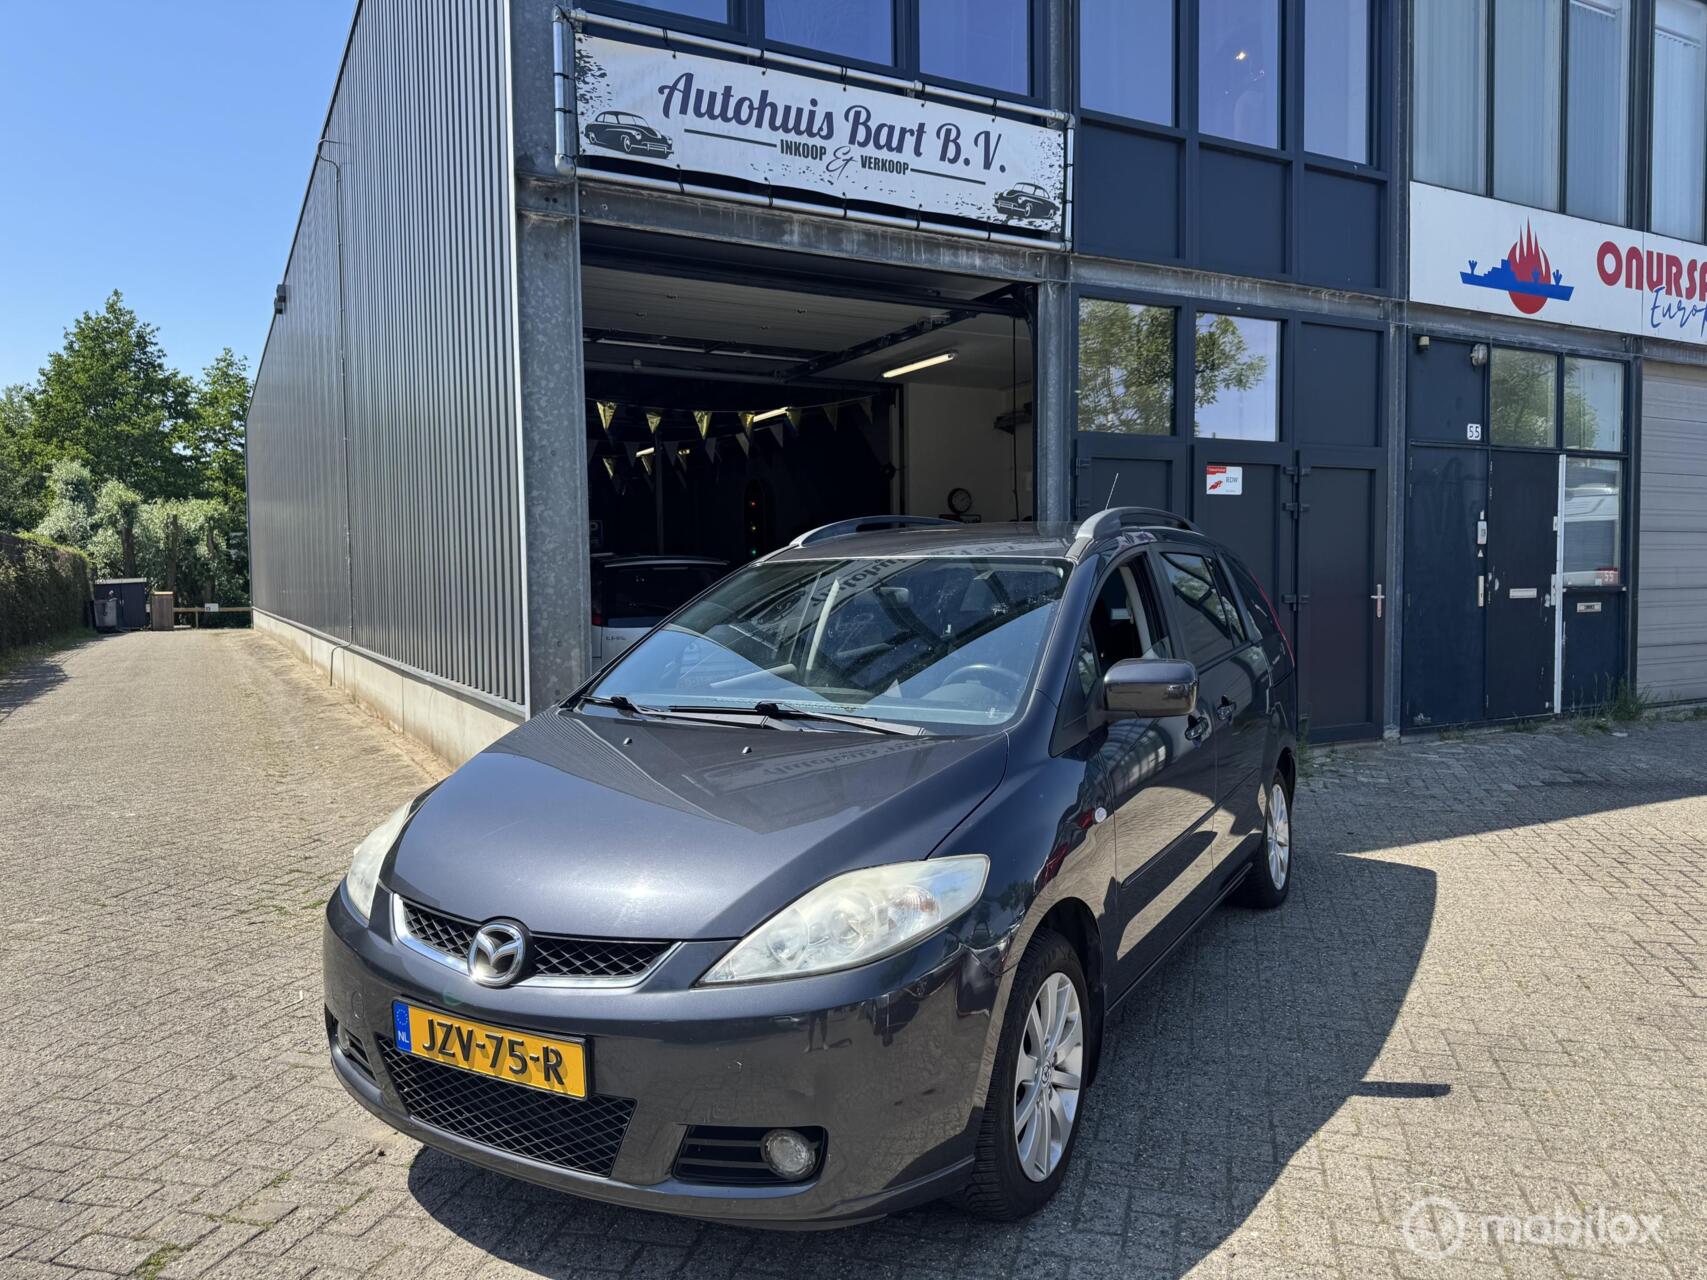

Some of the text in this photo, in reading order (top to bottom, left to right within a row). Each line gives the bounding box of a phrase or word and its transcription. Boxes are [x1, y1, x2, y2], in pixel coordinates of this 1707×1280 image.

[658, 72, 1006, 173] Autohuis Bart B.V.
[780, 139, 827, 161] INKOOP
[860, 154, 909, 175] VERKOOP
[1469, 425, 1480, 438] 55
[398, 1030, 410, 1044] NL
[422, 1018, 564, 1085] JZV-75-R
